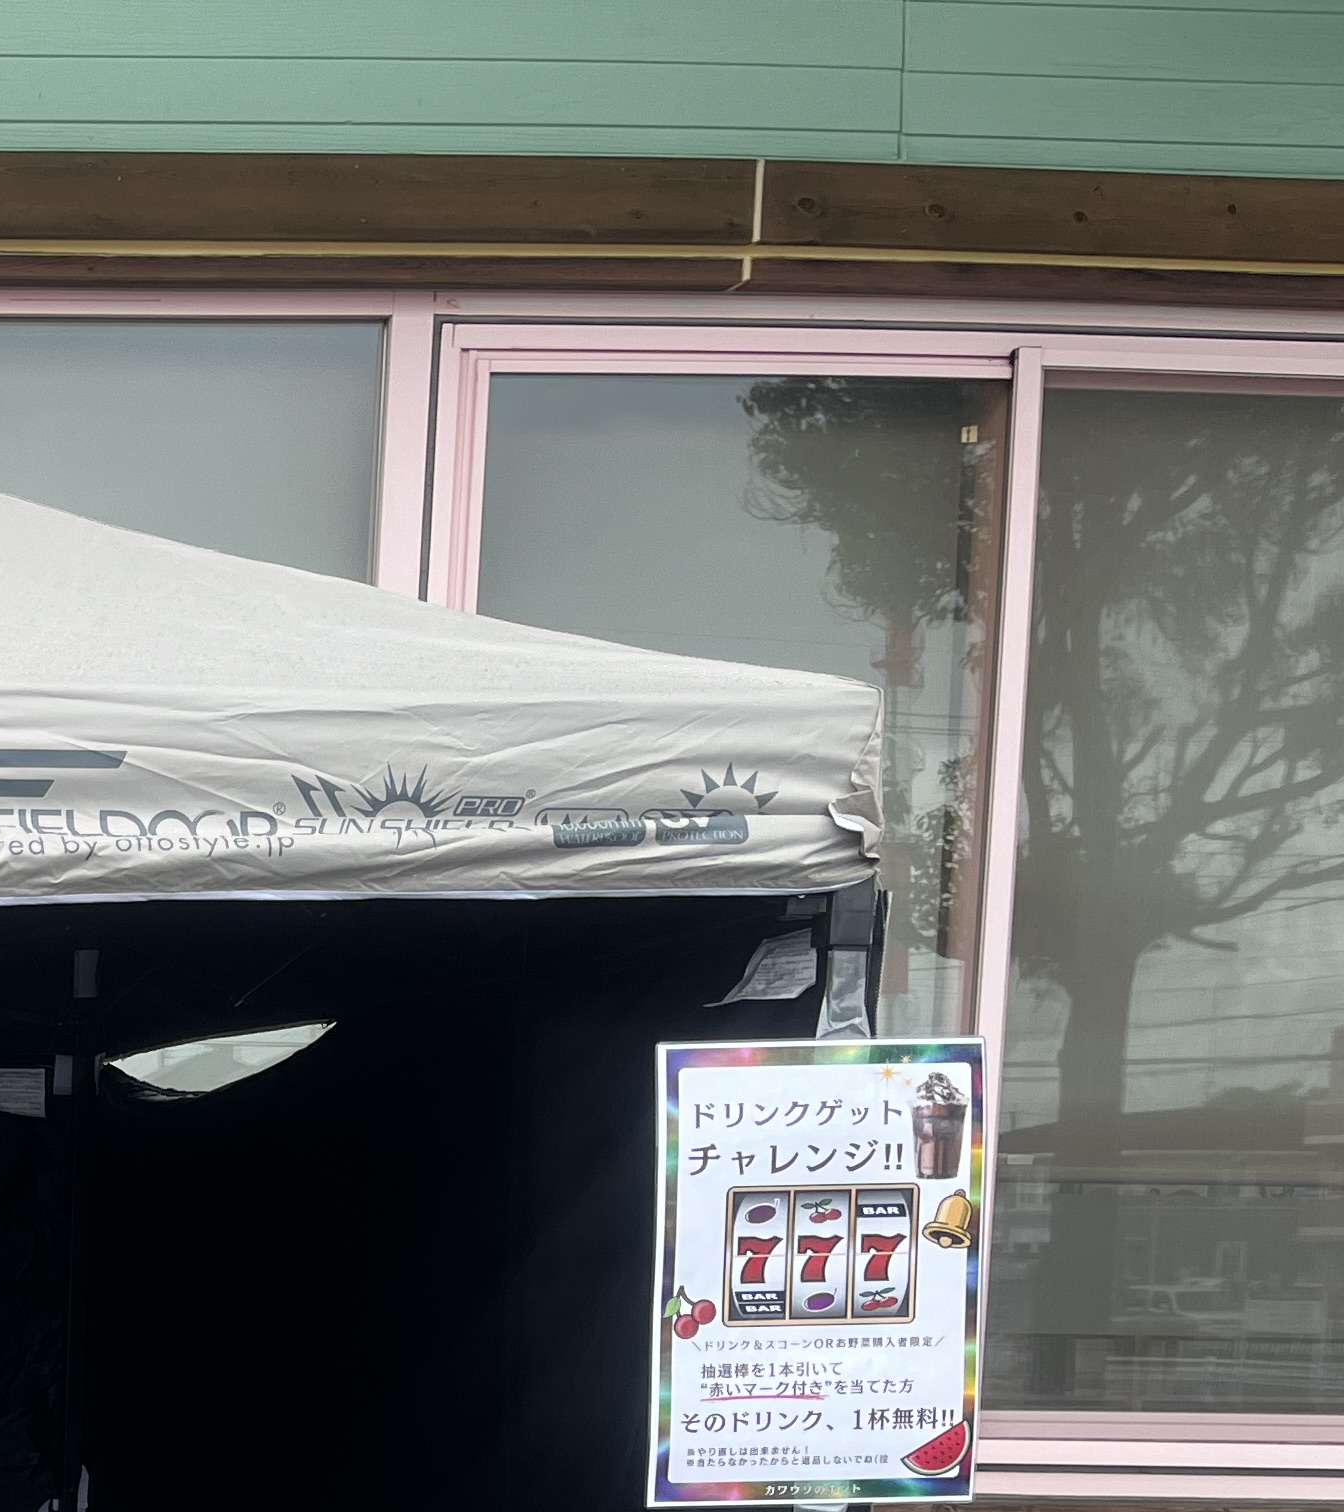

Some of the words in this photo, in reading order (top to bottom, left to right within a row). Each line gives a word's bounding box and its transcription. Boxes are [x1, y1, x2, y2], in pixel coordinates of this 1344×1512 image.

[457, 798, 522, 816] PRO
[63, 836, 97, 860] by
[694, 1099, 903, 1129] ドリンクゲット
[688, 1139, 904, 1176] チャレンジ!!
[862, 1207, 900, 1215] BAR
[741, 1293, 779, 1301] BAR
[745, 1304, 782, 1312] BAR
[701, 1361, 843, 1379] 抽選棒を1本引いて
